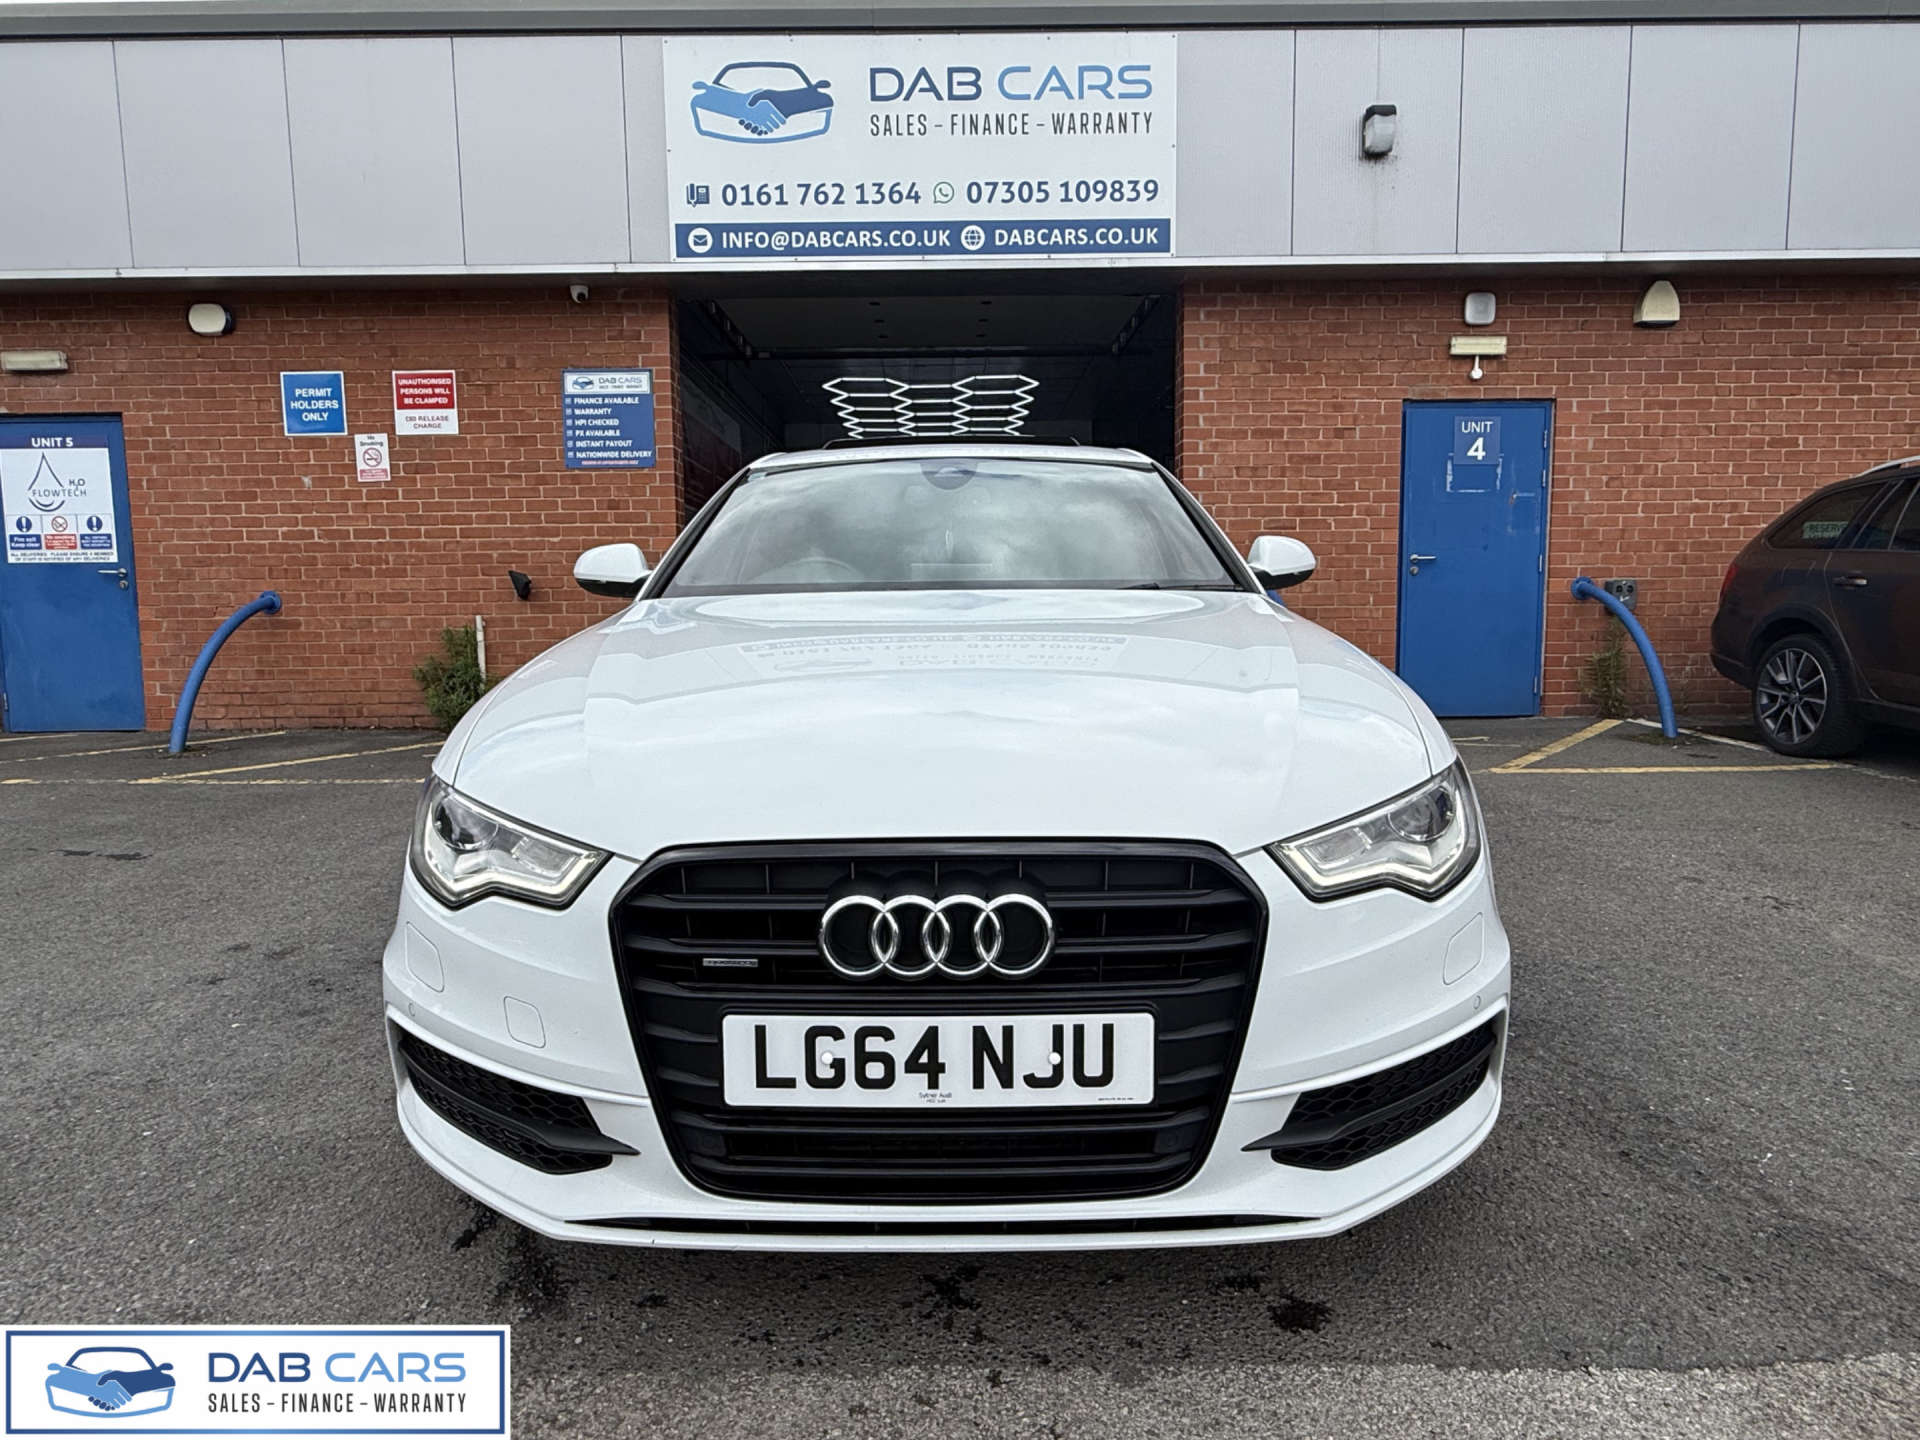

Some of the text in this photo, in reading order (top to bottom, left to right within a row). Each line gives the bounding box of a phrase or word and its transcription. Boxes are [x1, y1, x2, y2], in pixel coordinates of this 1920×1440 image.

[870, 65, 1152, 101] DAB CARS
[870, 113, 928, 136] SALES
[950, 113, 1030, 136] FINANCE
[1051, 112, 1152, 135] WARRANTY
[722, 182, 921, 206] 0161 762 1364
[966, 179, 1159, 203] 07305 109839
[722, 230, 951, 250] INFO@DABCARS.CO.UK
[995, 228, 1159, 246] DABCARS.CO.UK
[295, 388, 332, 397] PERMIT
[290, 400, 339, 410] HOLDERS
[302, 412, 329, 421] ONLY
[1461, 421, 1494, 433] UNIT
[31, 437, 74, 447] UNIT 5
[1466, 437, 1486, 461] 4
[32, 488, 87, 498] FLOWTECH
[754, 1024, 1114, 1089] LG64 NJU
